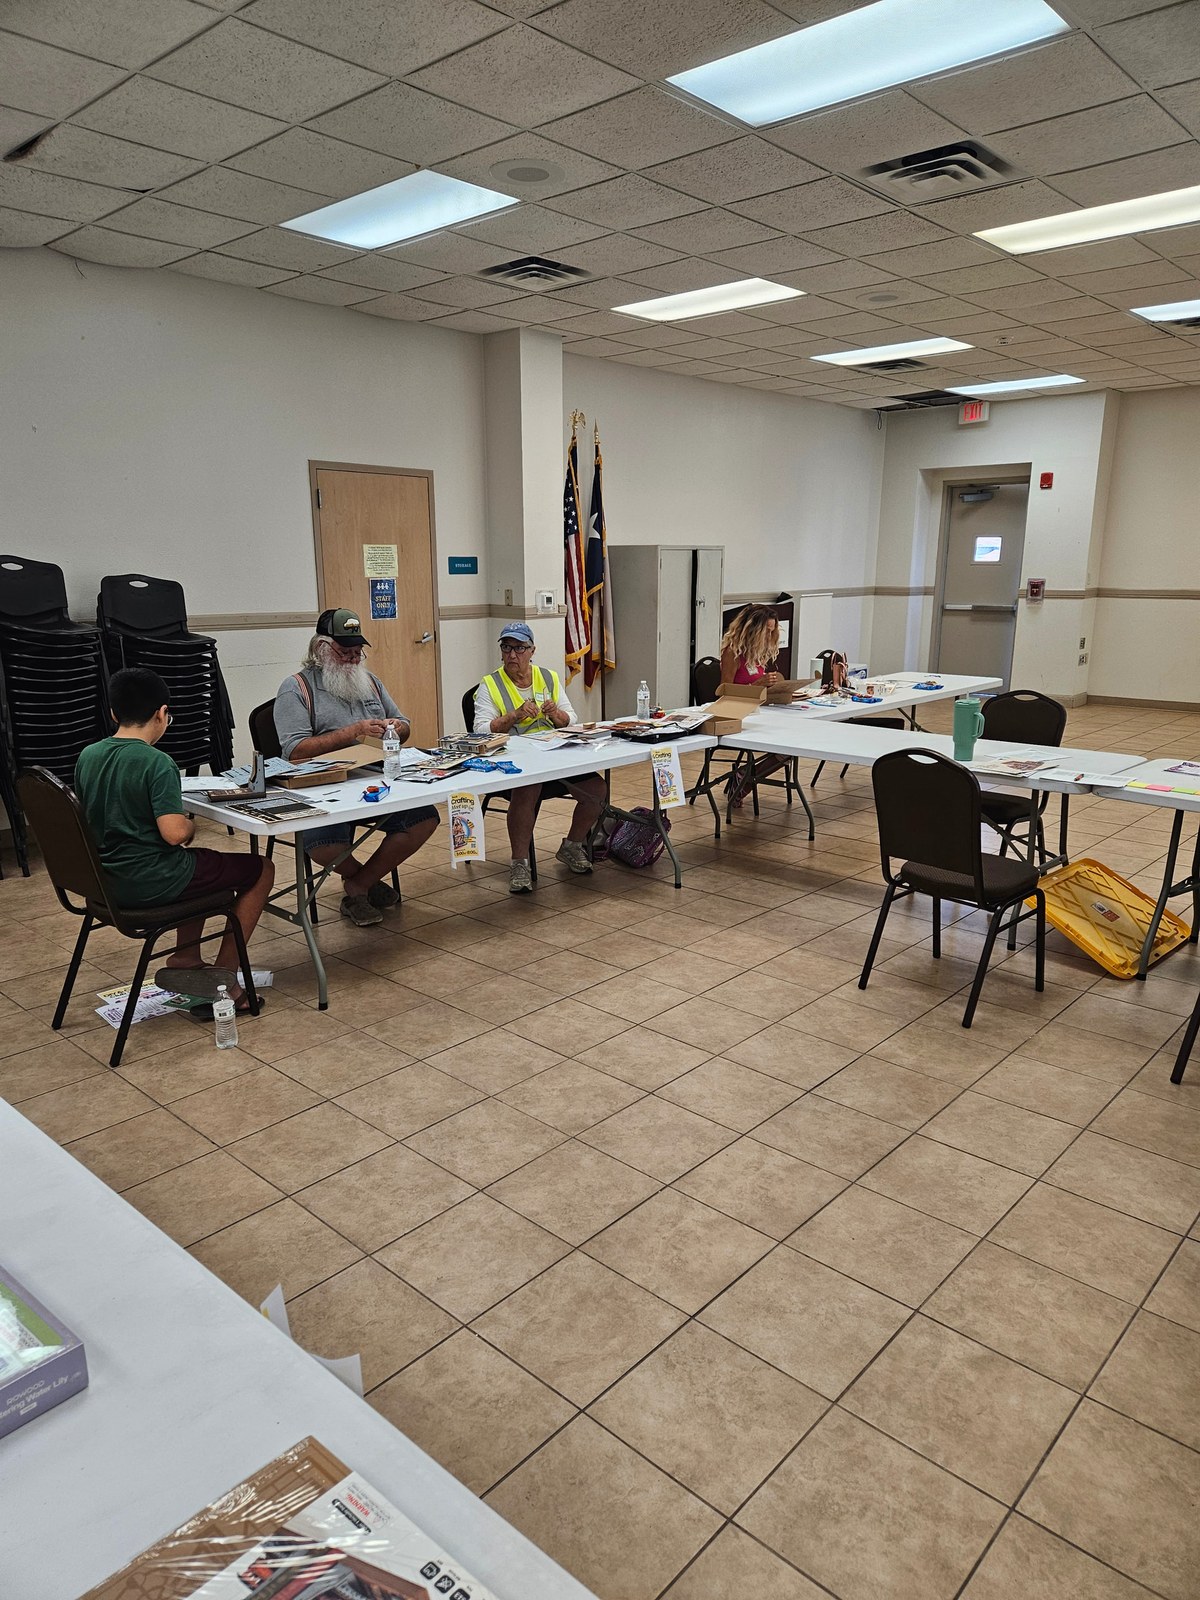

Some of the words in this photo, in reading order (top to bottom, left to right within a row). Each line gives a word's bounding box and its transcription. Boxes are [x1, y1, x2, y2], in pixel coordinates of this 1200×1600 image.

[963, 402, 984, 421] EXIT
[451, 797, 475, 806] Crafting
[7, 1380, 45, 1406] ROWOOD
[26, 1385, 52, 1402] Water
[53, 1376, 69, 1388] Lily
[346, 1493, 371, 1518] WARNING
